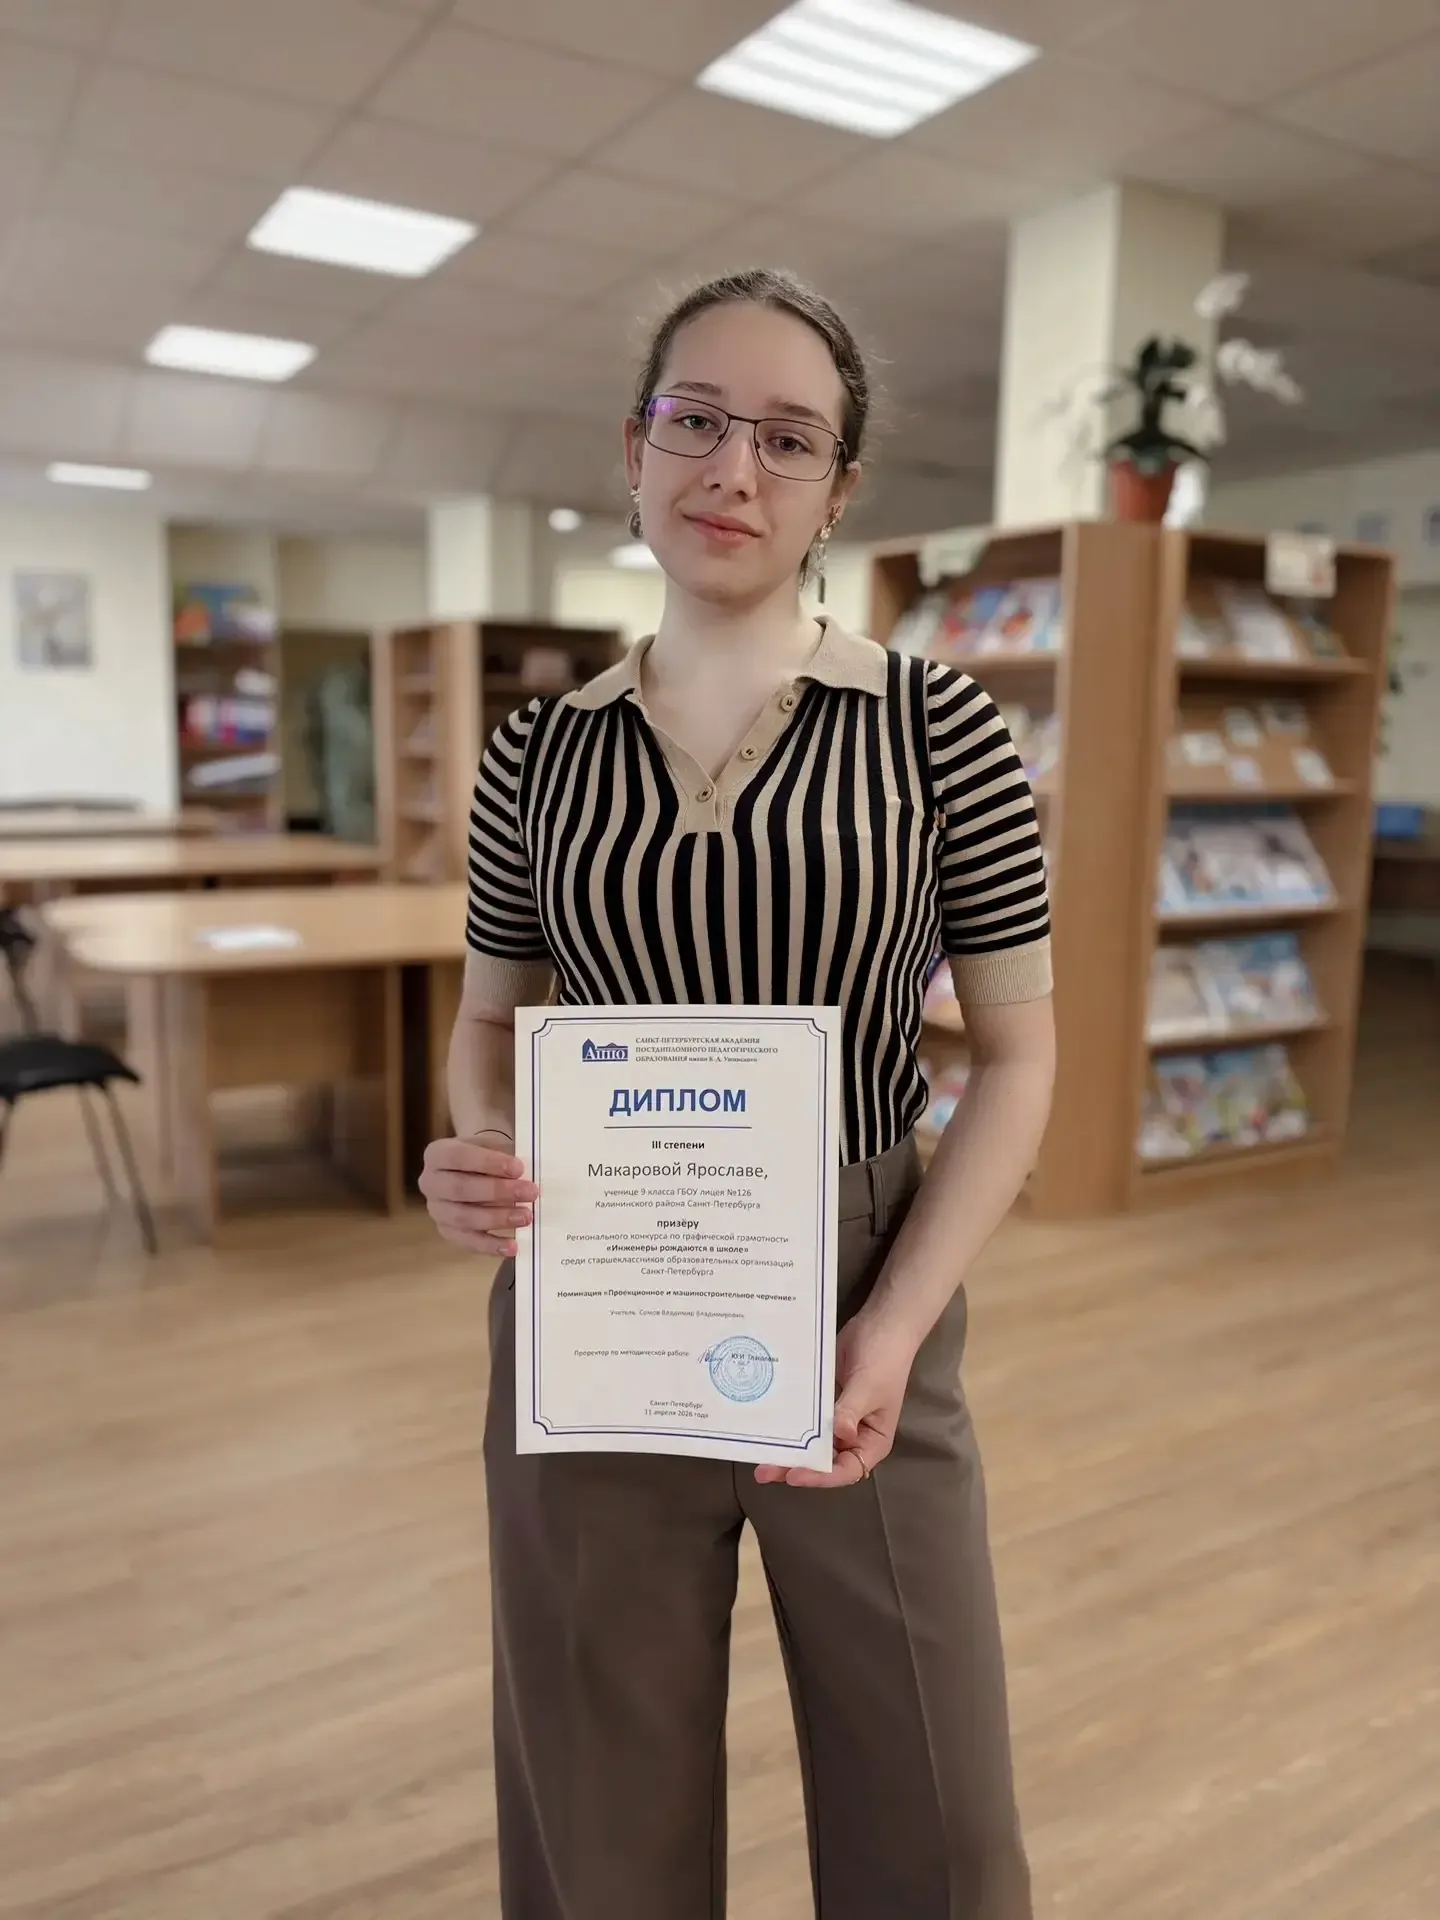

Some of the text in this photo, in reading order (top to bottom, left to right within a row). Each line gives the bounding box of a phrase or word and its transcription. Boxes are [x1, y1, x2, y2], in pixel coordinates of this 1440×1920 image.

[635, 1055, 688, 1063] ОБРАЗОВАНИЯ
[609, 1088, 746, 1117] ДИПЛОМ
[651, 1140, 705, 1150] III степени
[588, 1162, 768, 1180] Макаровой Ярославе,
[603, 1187, 752, 1198] ученице 9 класса ГБОУ лицея №126
[595, 1200, 760, 1209] Калининского района Санкт-Петербурга
[656, 1218, 699, 1229] призёру
[566, 1233, 628, 1242] Регионального
[630, 1233, 668, 1242] конкурса
[682, 1232, 735, 1242] графической
[736, 1234, 789, 1243] грамотности
[606, 1244, 658, 1253] «Инженеры
[659, 1244, 708, 1253] рождаются
[716, 1246, 749, 1254] школе»
[560, 1255, 794, 1268] среди старшеклассников образовательных организаций
[640, 1267, 714, 1277] Санкт-Петербурга
[557, 1290, 602, 1298] Номинация
[603, 1288, 665, 1297] «Проекционное
[672, 1290, 755, 1300] машиностроительное
[756, 1294, 797, 1302] черчение»
[661, 1309, 695, 1318] Владимир
[620, 1349, 666, 1357] методической
[649, 1400, 703, 1410] Санкт-Петербург
